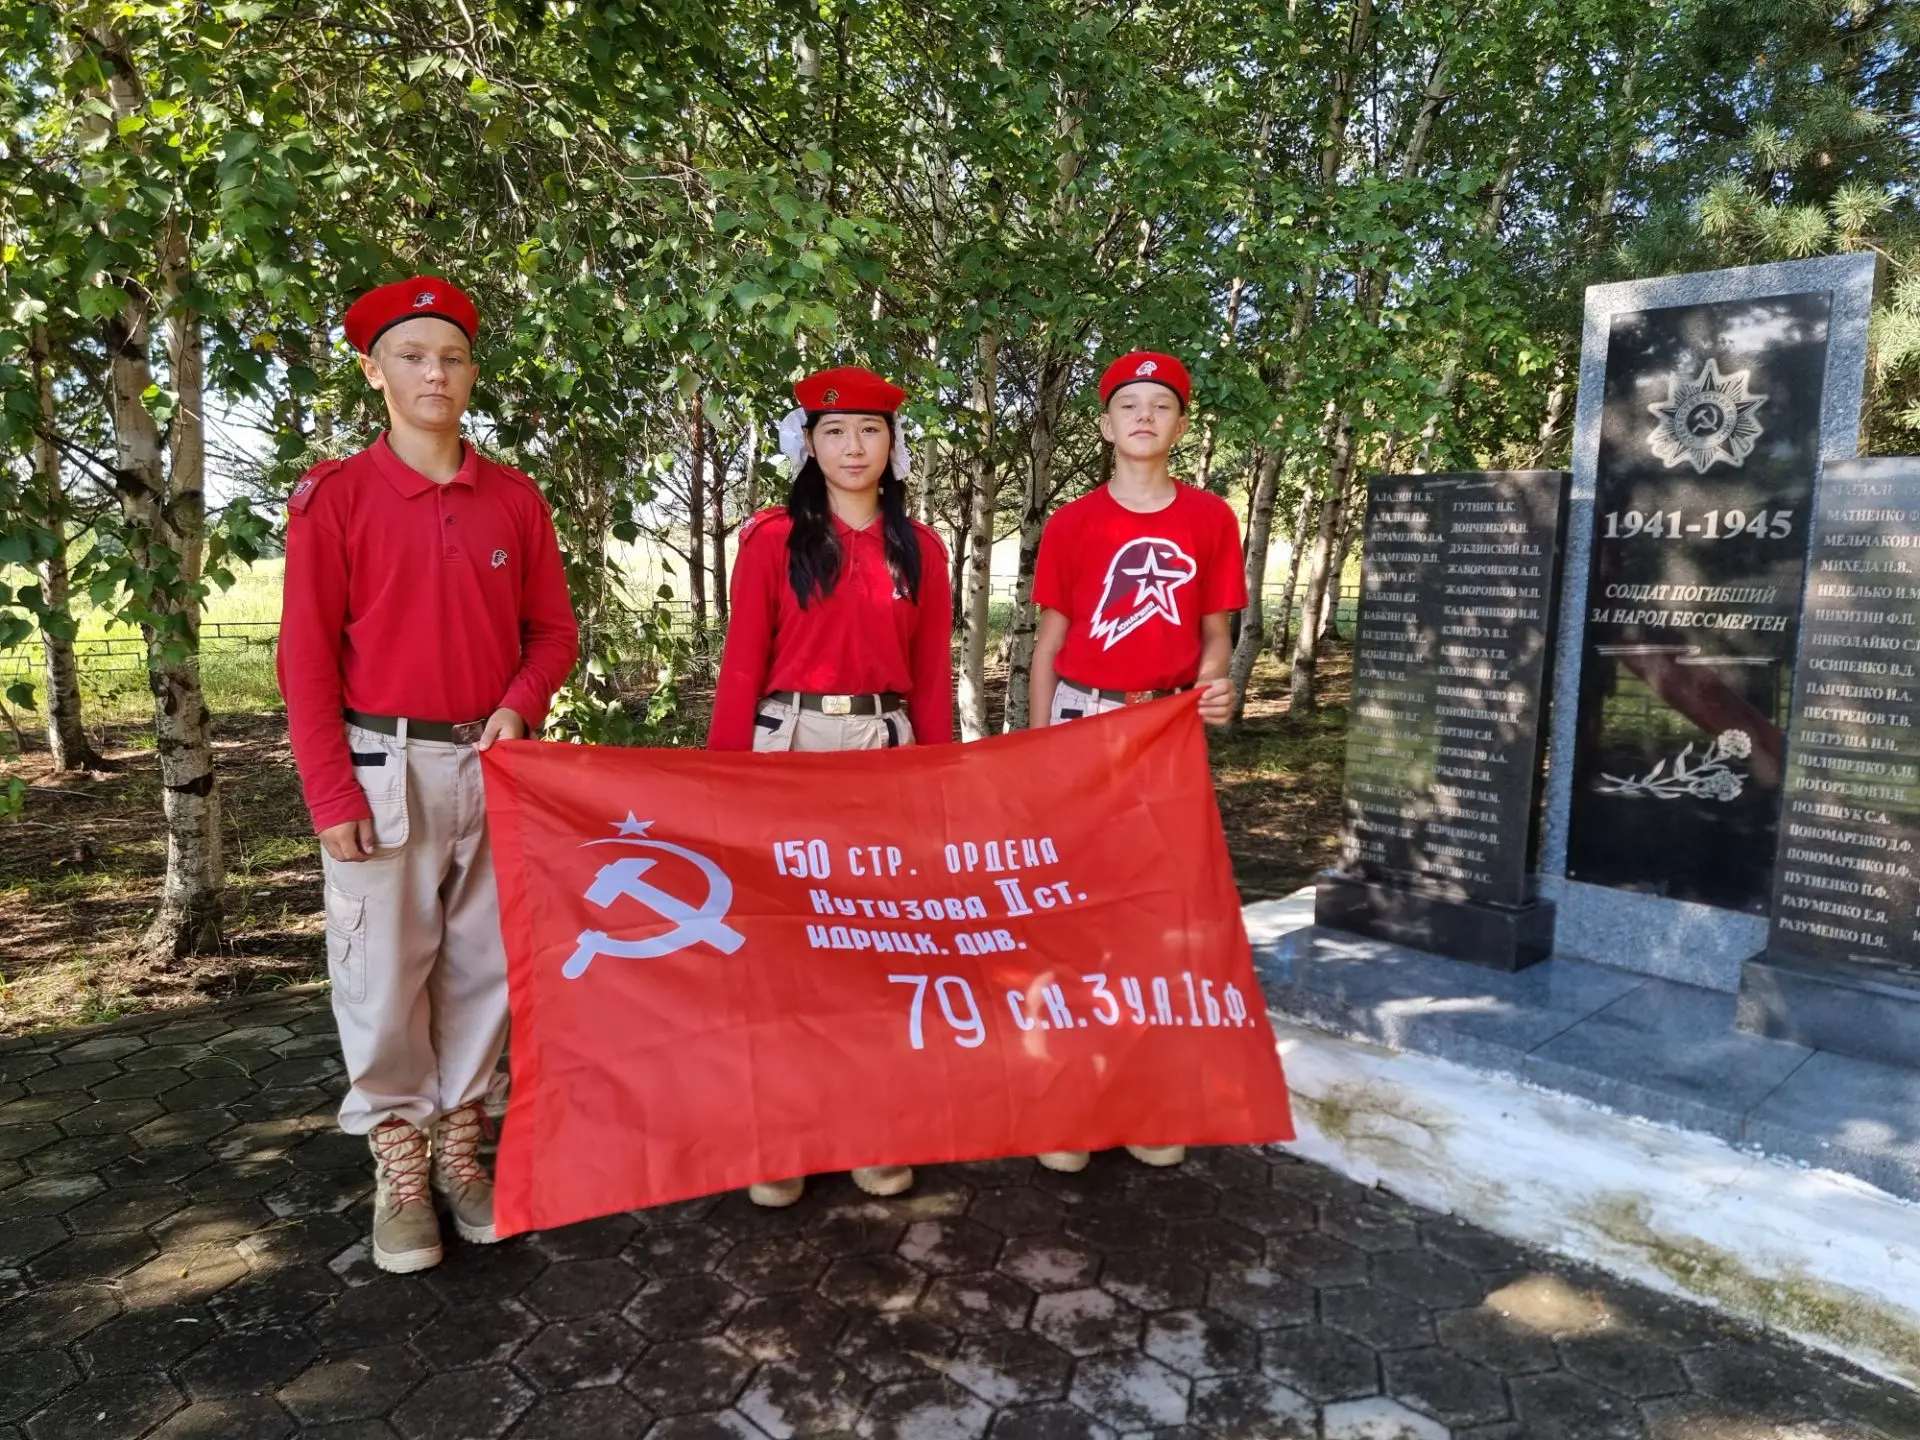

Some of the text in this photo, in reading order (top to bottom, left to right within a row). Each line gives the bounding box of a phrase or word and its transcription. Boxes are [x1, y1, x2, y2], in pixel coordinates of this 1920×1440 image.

[1603, 509, 1793, 539] 1941-1945
[1605, 584, 1777, 604] СОЛДАТ ПОГИБШИЙ
[1818, 585, 1892, 598] НЕДЕЛЬКО
[1591, 608, 1789, 632] ЗА НАРОД БЕССМЕРТЕН
[1809, 658, 1887, 674] ОСИПЕНКО
[1806, 682, 1883, 699] ПАНЧЕНКО
[1803, 706, 1885, 725] ПЕСТРЕЦОВ
[1790, 824, 1887, 849] ПОНОМАРЕНКО
[773, 837, 1059, 880] 150 СТР. ОРДЕНА
[1786, 848, 1884, 873] ПОНОМАРЕНКО
[1781, 894, 1861, 919] РАЗУМЕНКО
[1779, 918, 1858, 943] РАЗУМЕНКО
[888, 973, 986, 1050] 79
